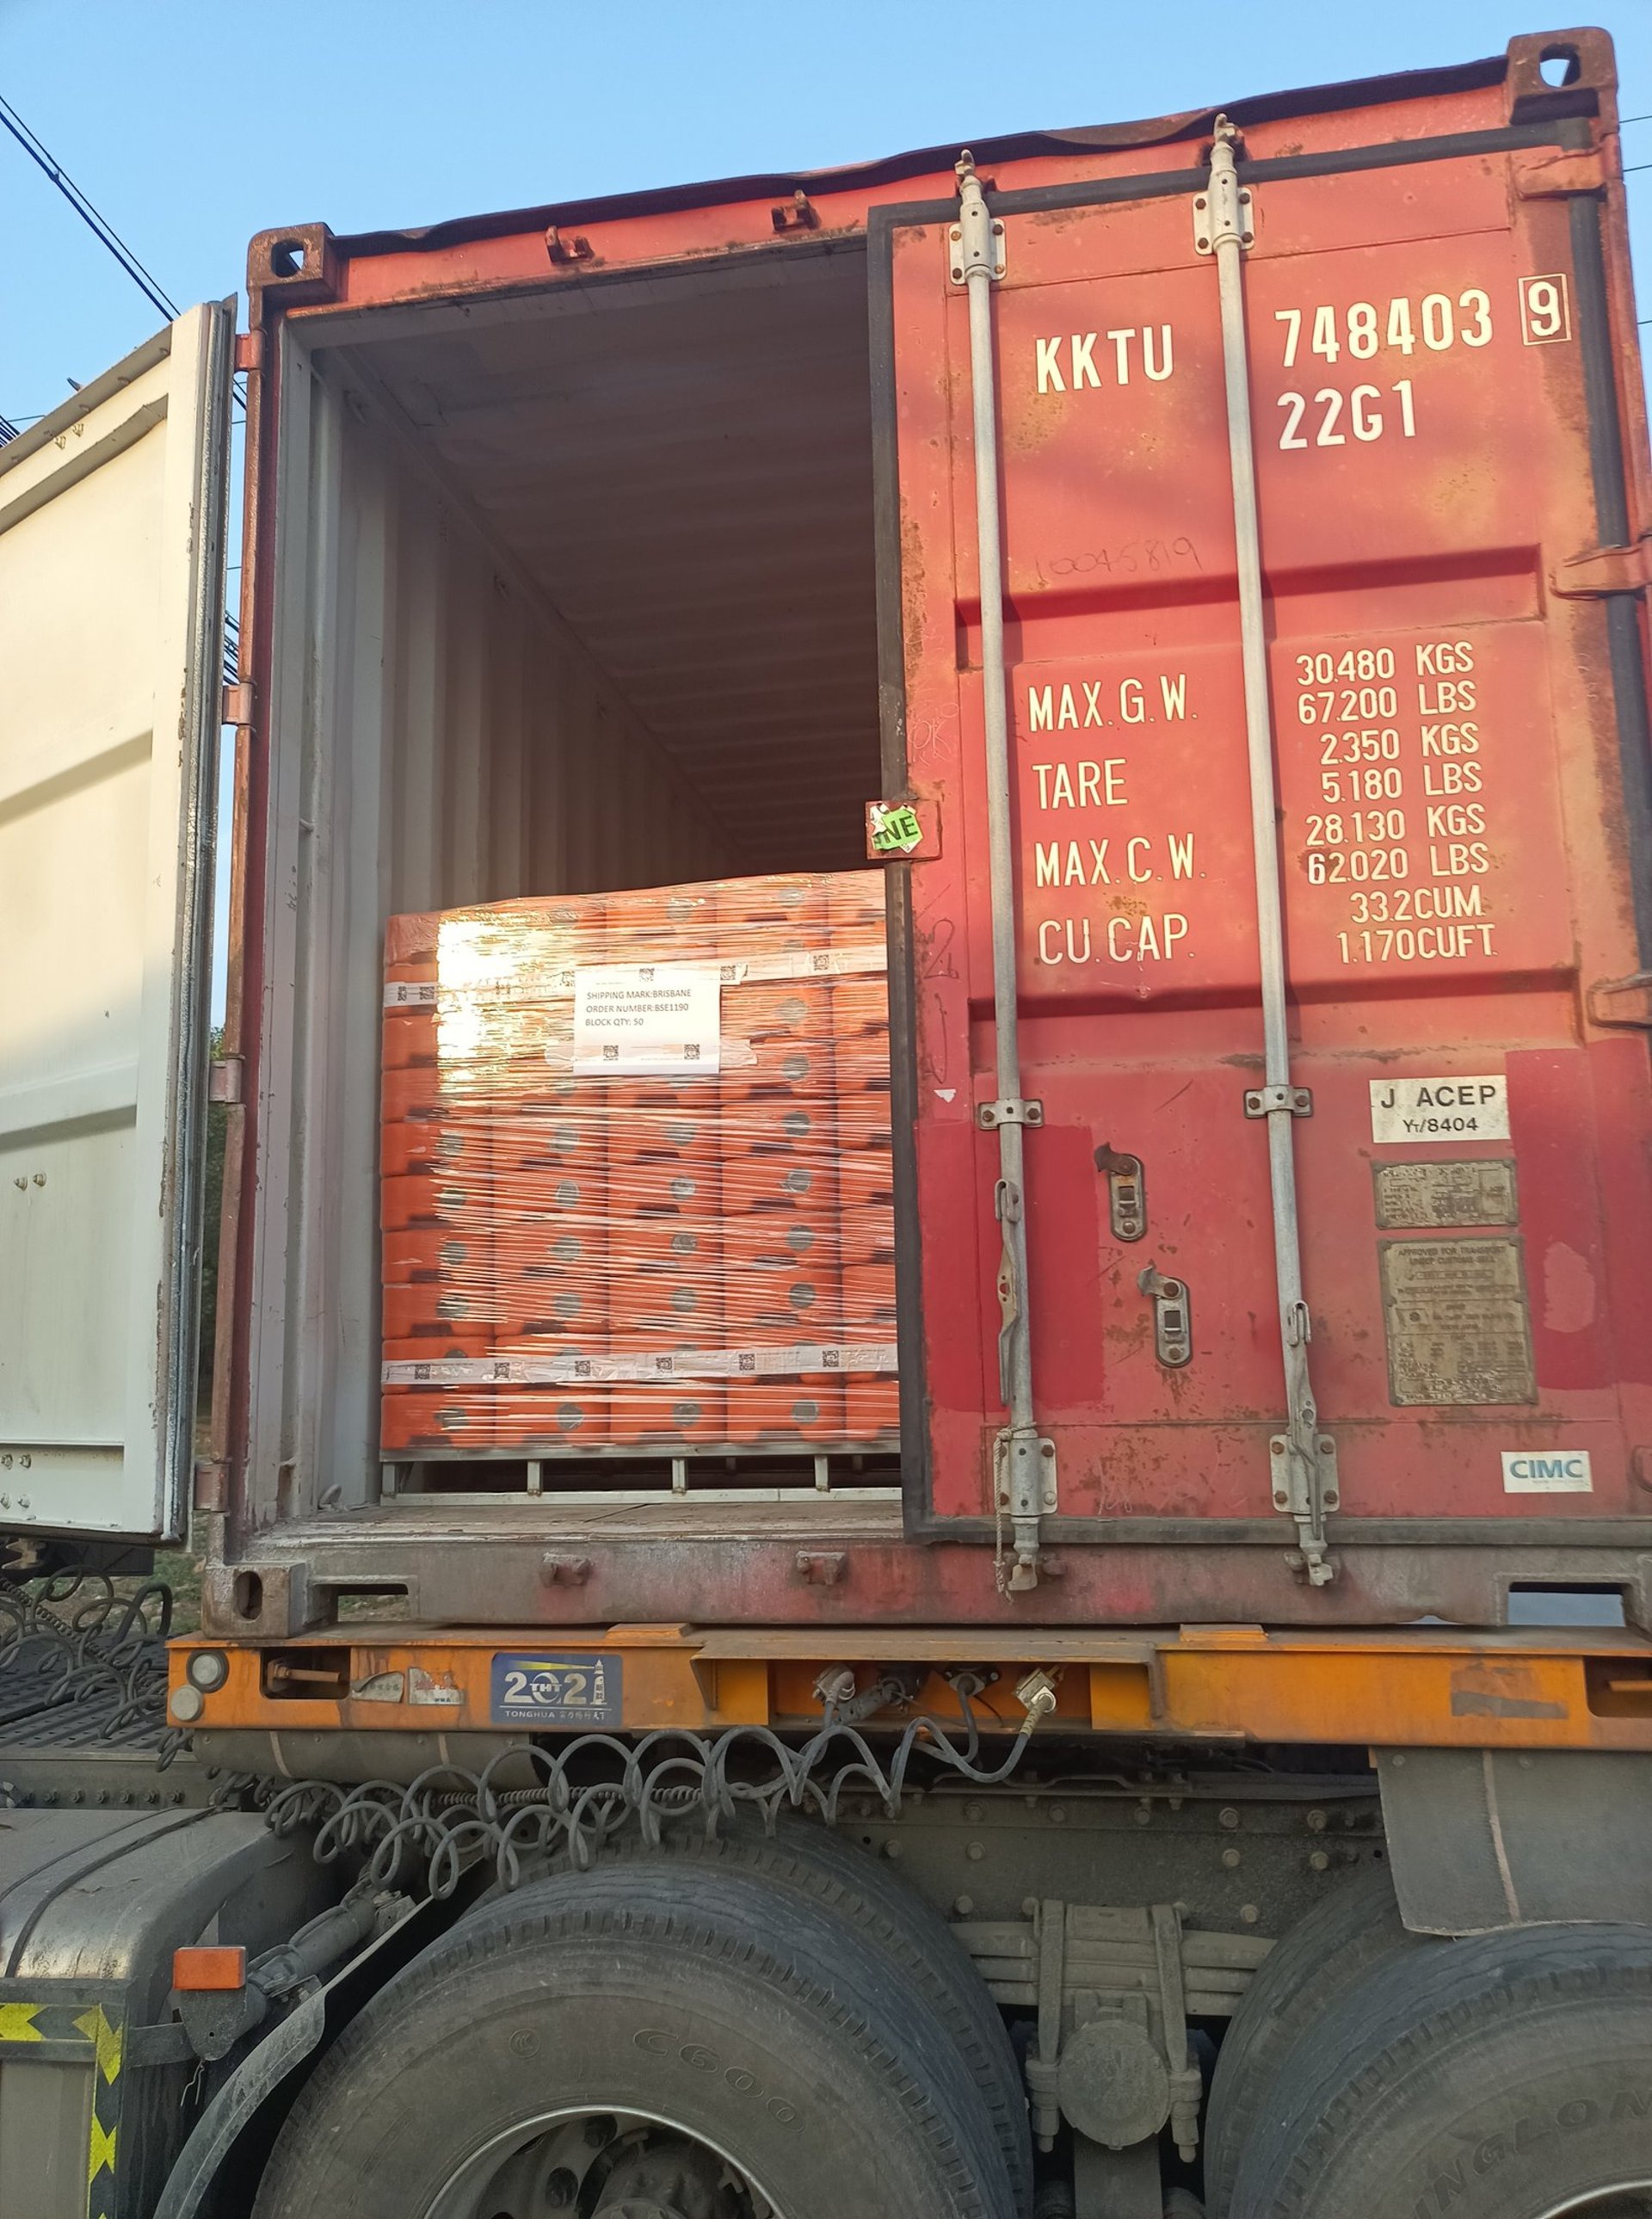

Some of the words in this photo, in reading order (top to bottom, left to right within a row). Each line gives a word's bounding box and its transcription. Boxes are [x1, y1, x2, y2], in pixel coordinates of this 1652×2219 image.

[1274, 289, 1493, 367] 748403
[1526, 281, 1563, 336] 9
[1036, 324, 1174, 393] KKTU
[1277, 379, 1416, 450] 22G1
[1295, 648, 1396, 686] 30.480
[1415, 641, 1474, 676] KGS
[1298, 687, 1398, 724] 67.200
[1417, 680, 1476, 715] LBS
[1319, 728, 1400, 765] 2.350
[1421, 722, 1479, 757] KGS
[1032, 758, 1128, 810] TARE
[1321, 767, 1403, 804] 5.180
[1423, 761, 1482, 796] LBS
[1305, 809, 1406, 847] 28.130
[1426, 803, 1486, 838] KGS
[1307, 848, 1408, 885] 62.020
[1429, 841, 1489, 877] LBS
[586, 1005, 614, 1014] ORDER
[587, 991, 625, 1000] SHIPPING
[585, 1018, 612, 1026] BLOCK
[613, 1018, 631, 1026] QTY:
[1380, 1088, 1395, 1108] J
[1416, 1085, 1495, 1107] ACEP
[1509, 1459, 1583, 1478] CIMC
[505, 1710, 556, 1718] TONGHUA
